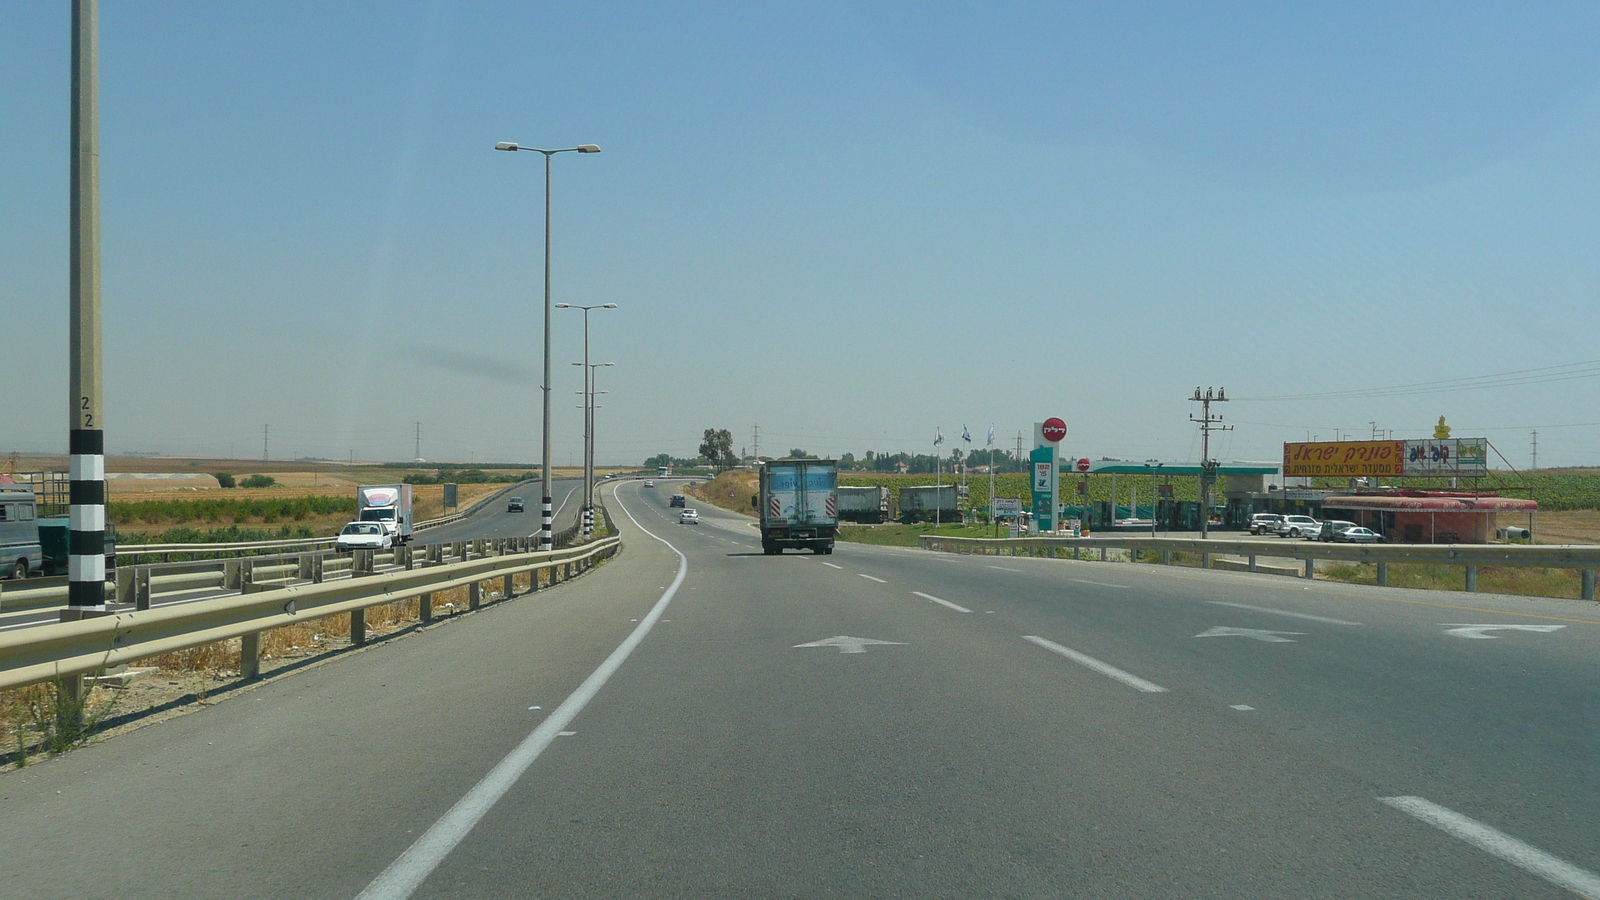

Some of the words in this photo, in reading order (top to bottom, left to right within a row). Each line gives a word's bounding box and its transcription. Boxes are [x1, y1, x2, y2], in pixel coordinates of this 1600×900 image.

[82, 397, 90, 410] 2
[85, 414, 93, 428] 2
[1293, 444, 1340, 461] ישראל
[1343, 446, 1392, 463] פונדק
[1293, 464, 1322, 474] מזרחית
[1324, 463, 1359, 474] ישראלית
[1361, 463, 1392, 474] מסעדה
